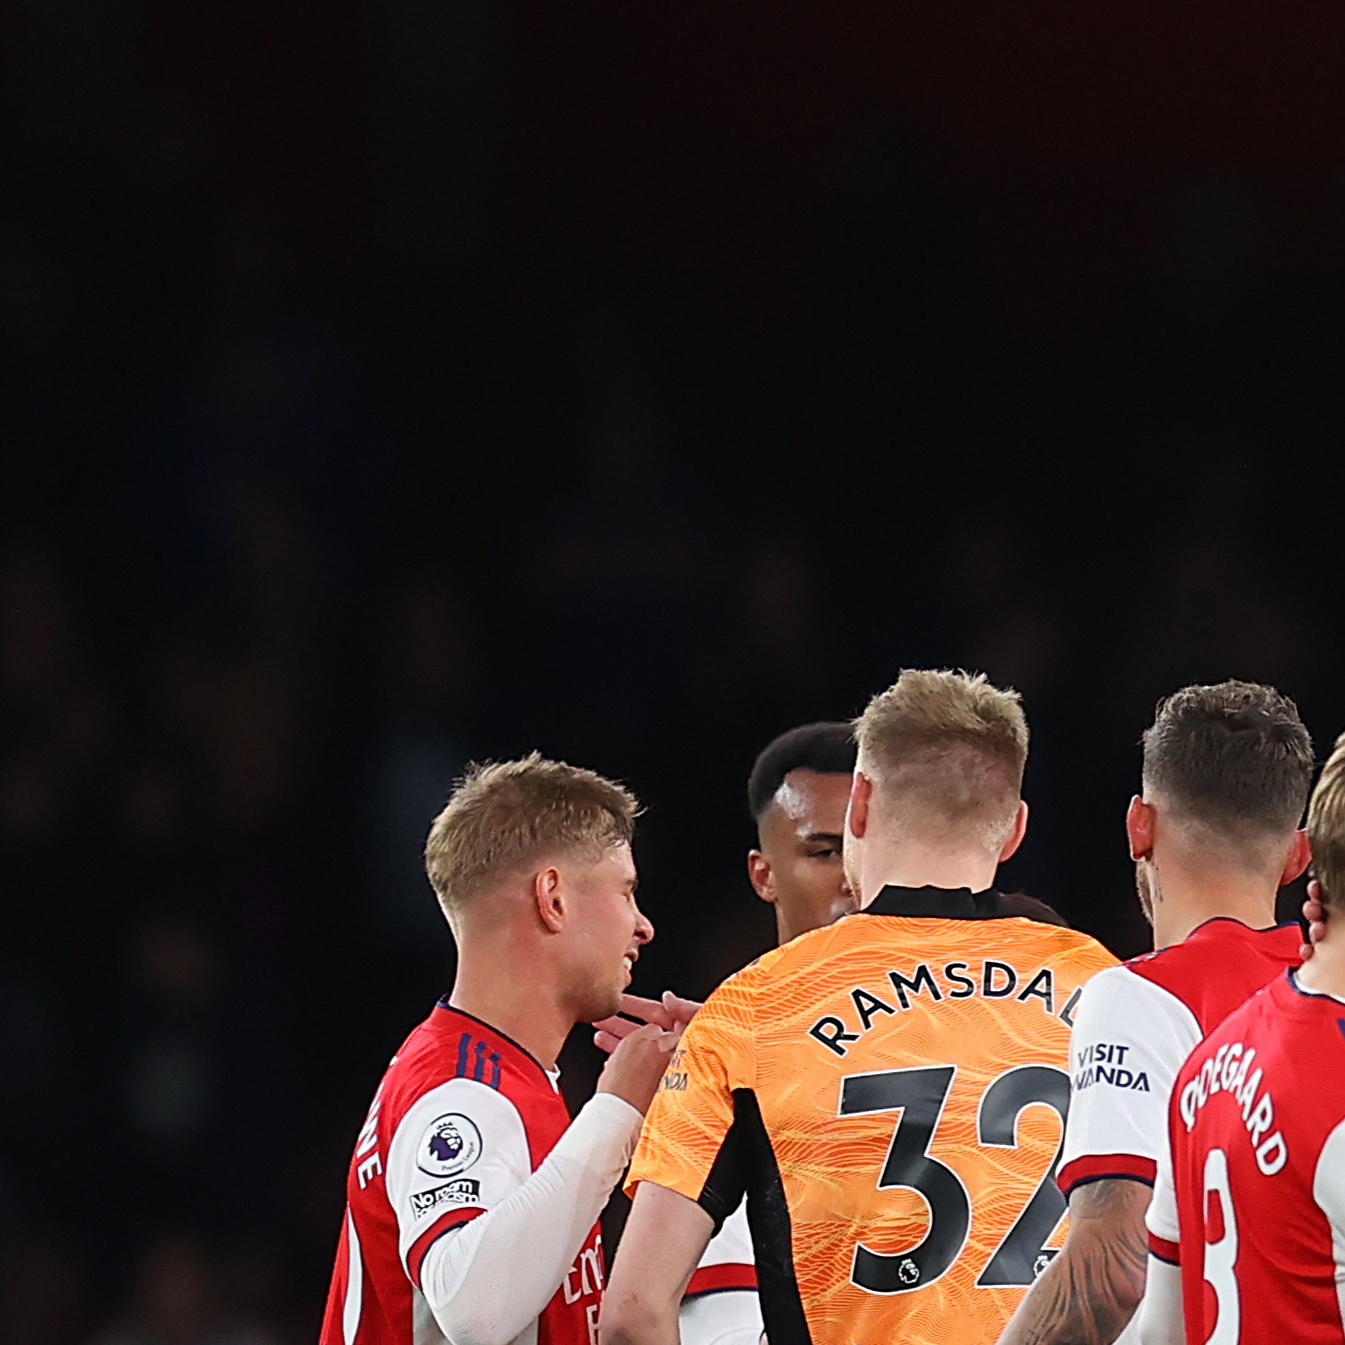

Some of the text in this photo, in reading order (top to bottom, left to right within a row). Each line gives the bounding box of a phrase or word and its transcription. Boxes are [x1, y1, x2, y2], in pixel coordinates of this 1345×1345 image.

[809, 961, 1084, 1057] RAMSDAL
[1077, 1043, 1129, 1066] VISIT
[1071, 1065, 1151, 1092] WANDA
[837, 1064, 1071, 1295] 32
[410, 1193, 435, 1209] No
